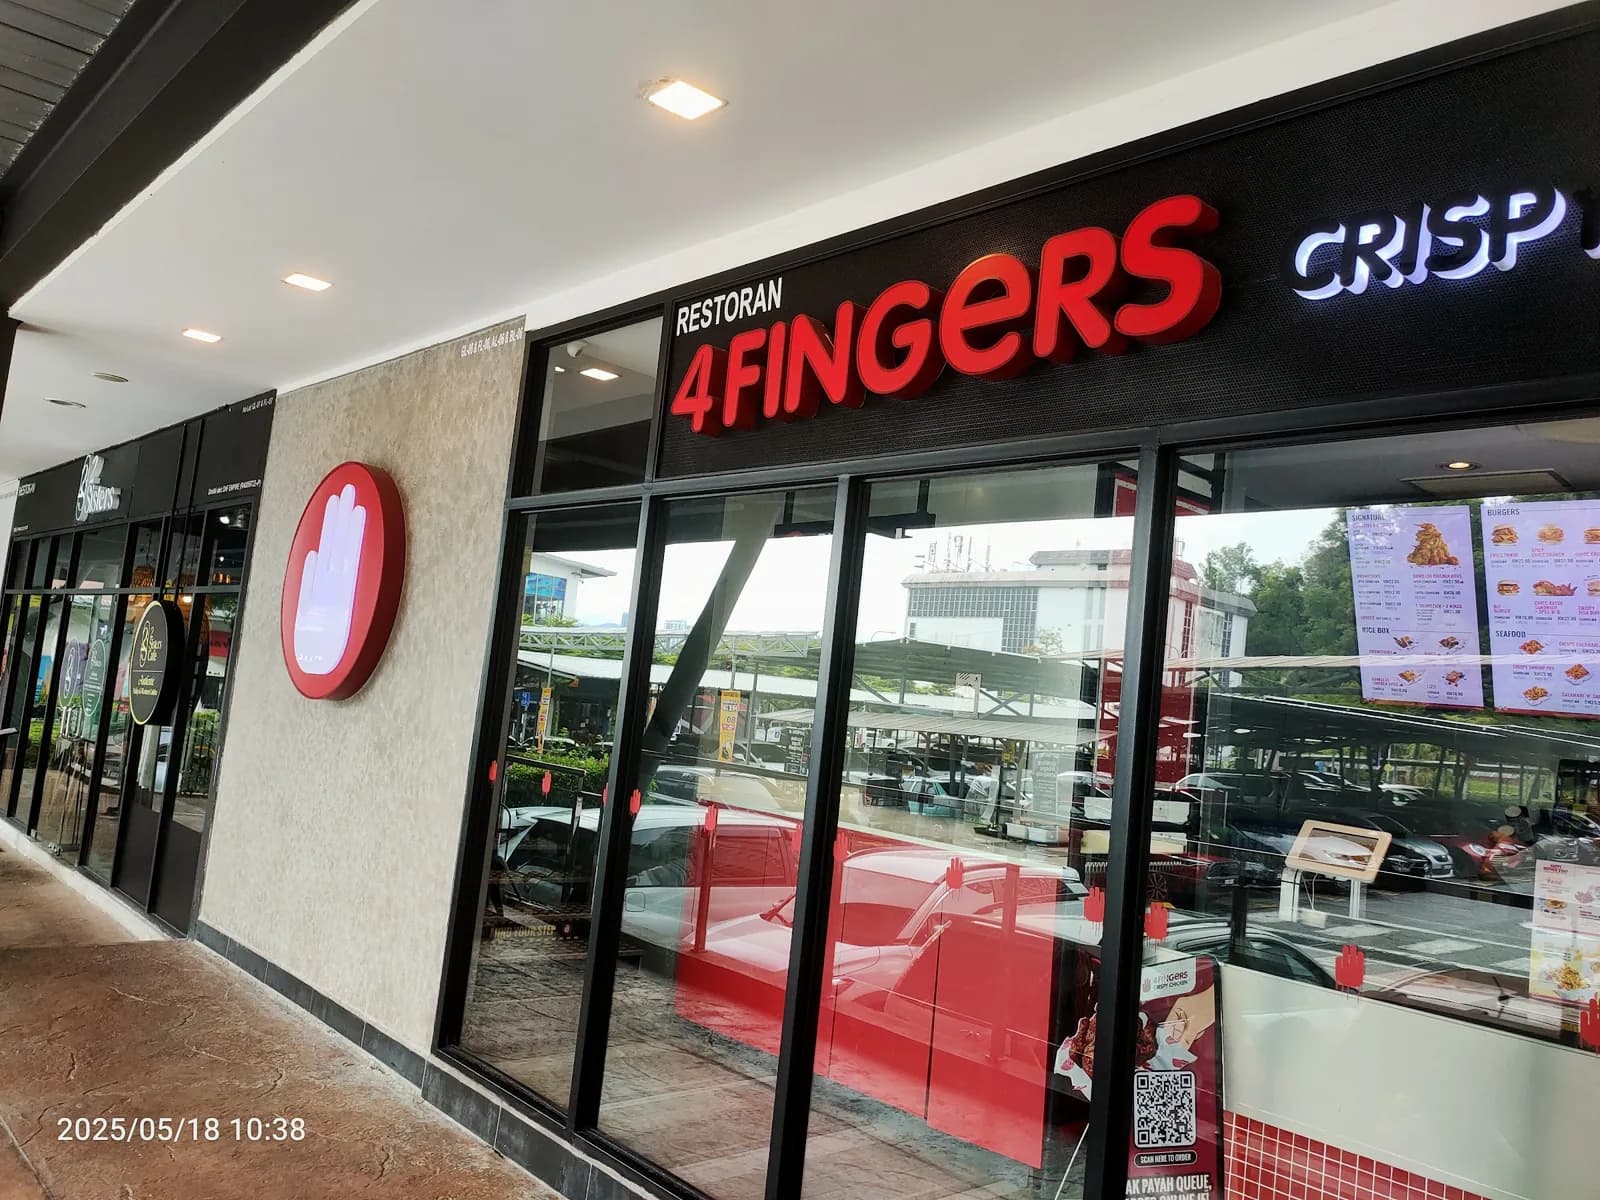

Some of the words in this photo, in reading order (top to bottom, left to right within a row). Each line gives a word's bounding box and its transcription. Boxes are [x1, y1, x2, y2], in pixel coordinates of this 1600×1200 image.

[676, 277, 782, 336] RESTORAN
[1487, 508, 1520, 517] BURGERS
[1377, 627, 1390, 635] BOX
[1495, 630, 1526, 638] SEAFOOD
[1140, 1155, 1154, 1164] SCAN
[1154, 1155, 1168, 1163] HERE
[1168, 1154, 1175, 1162] TO
[1175, 1153, 1192, 1162] ORDER
[1125, 1179, 1140, 1195] AK
[1142, 1177, 1174, 1194] PAYAH
[1176, 1174, 1212, 1192] QUEUE,
